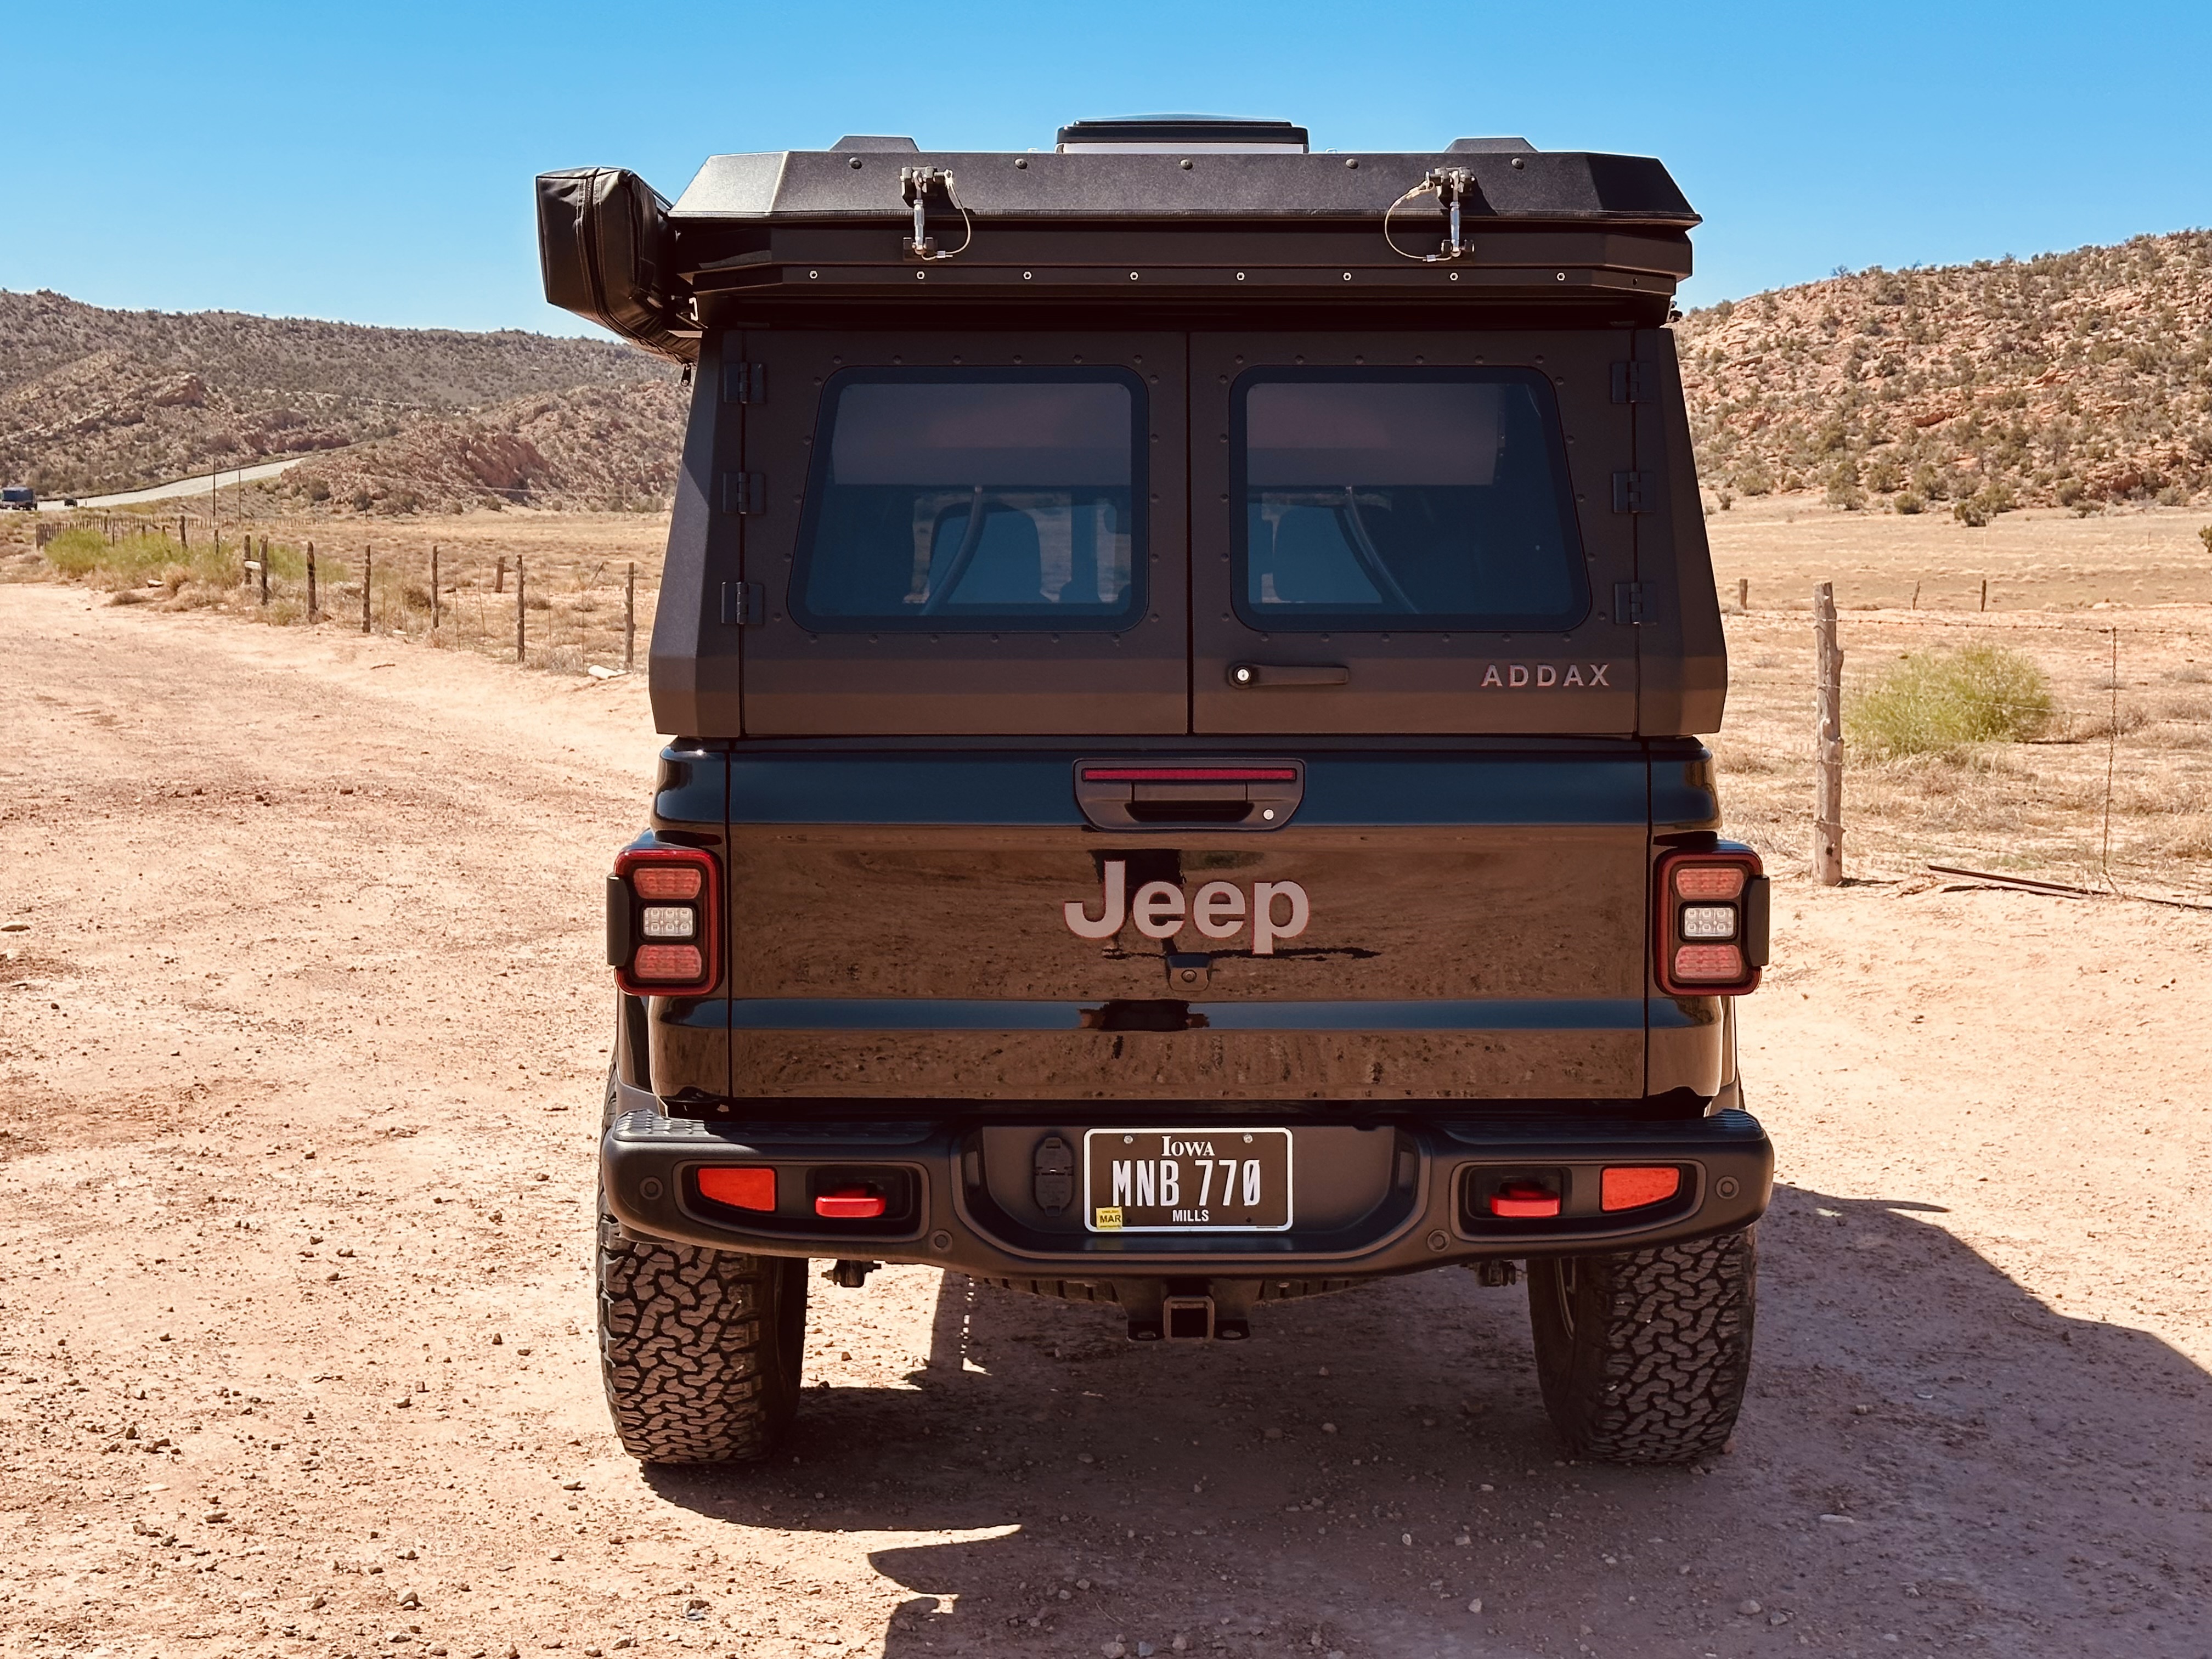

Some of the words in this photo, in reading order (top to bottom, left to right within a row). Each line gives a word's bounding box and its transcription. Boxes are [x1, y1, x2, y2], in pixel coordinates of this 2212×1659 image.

[1481, 663, 1610, 686] ADDAX
[1064, 860, 1310, 955] Jeep
[1113, 1160, 1180, 1206] MNB
[1194, 1159, 1261, 1206] 770
[1172, 1209, 1210, 1222] MILLS
